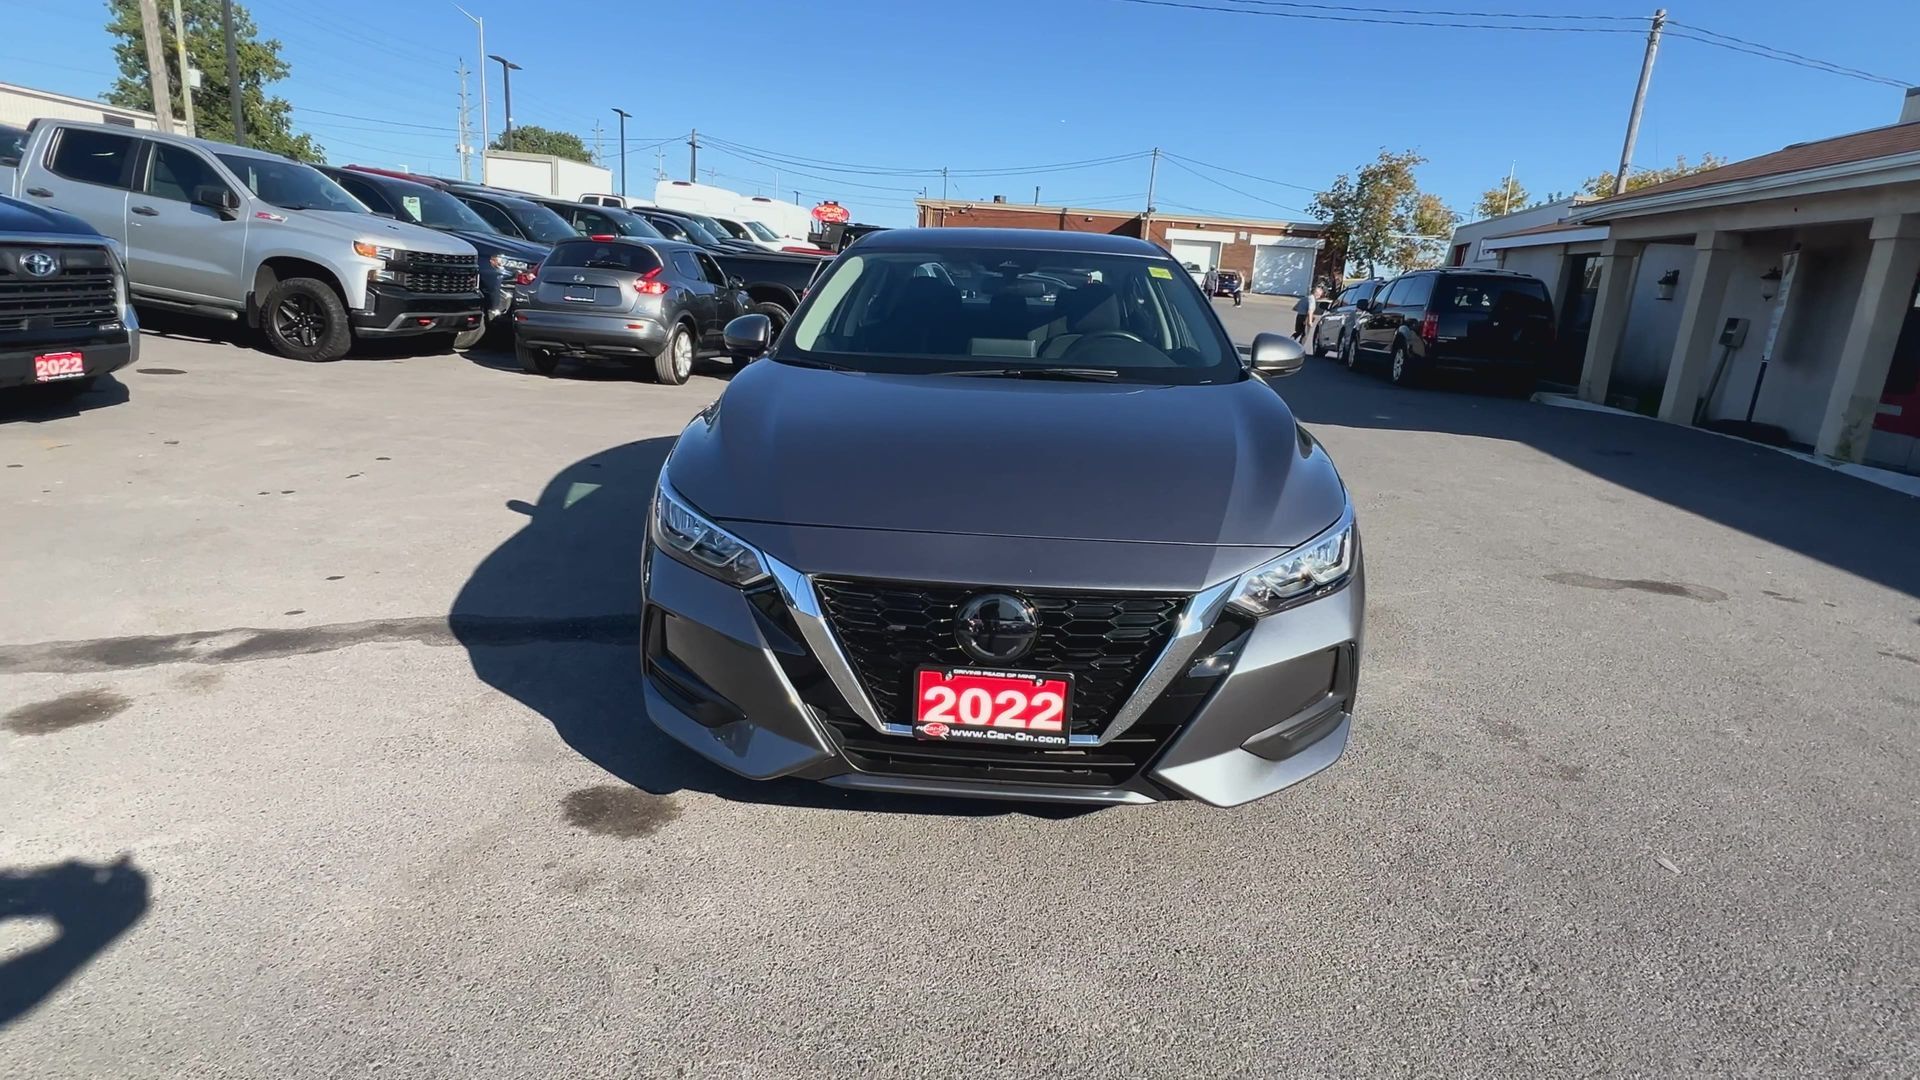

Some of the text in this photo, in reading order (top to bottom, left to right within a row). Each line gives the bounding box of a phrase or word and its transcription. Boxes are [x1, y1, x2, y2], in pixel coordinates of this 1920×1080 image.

[36, 357, 83, 377] 2022
[923, 685, 1064, 731] 2022
[951, 729, 1066, 744] www.Car-On.com
